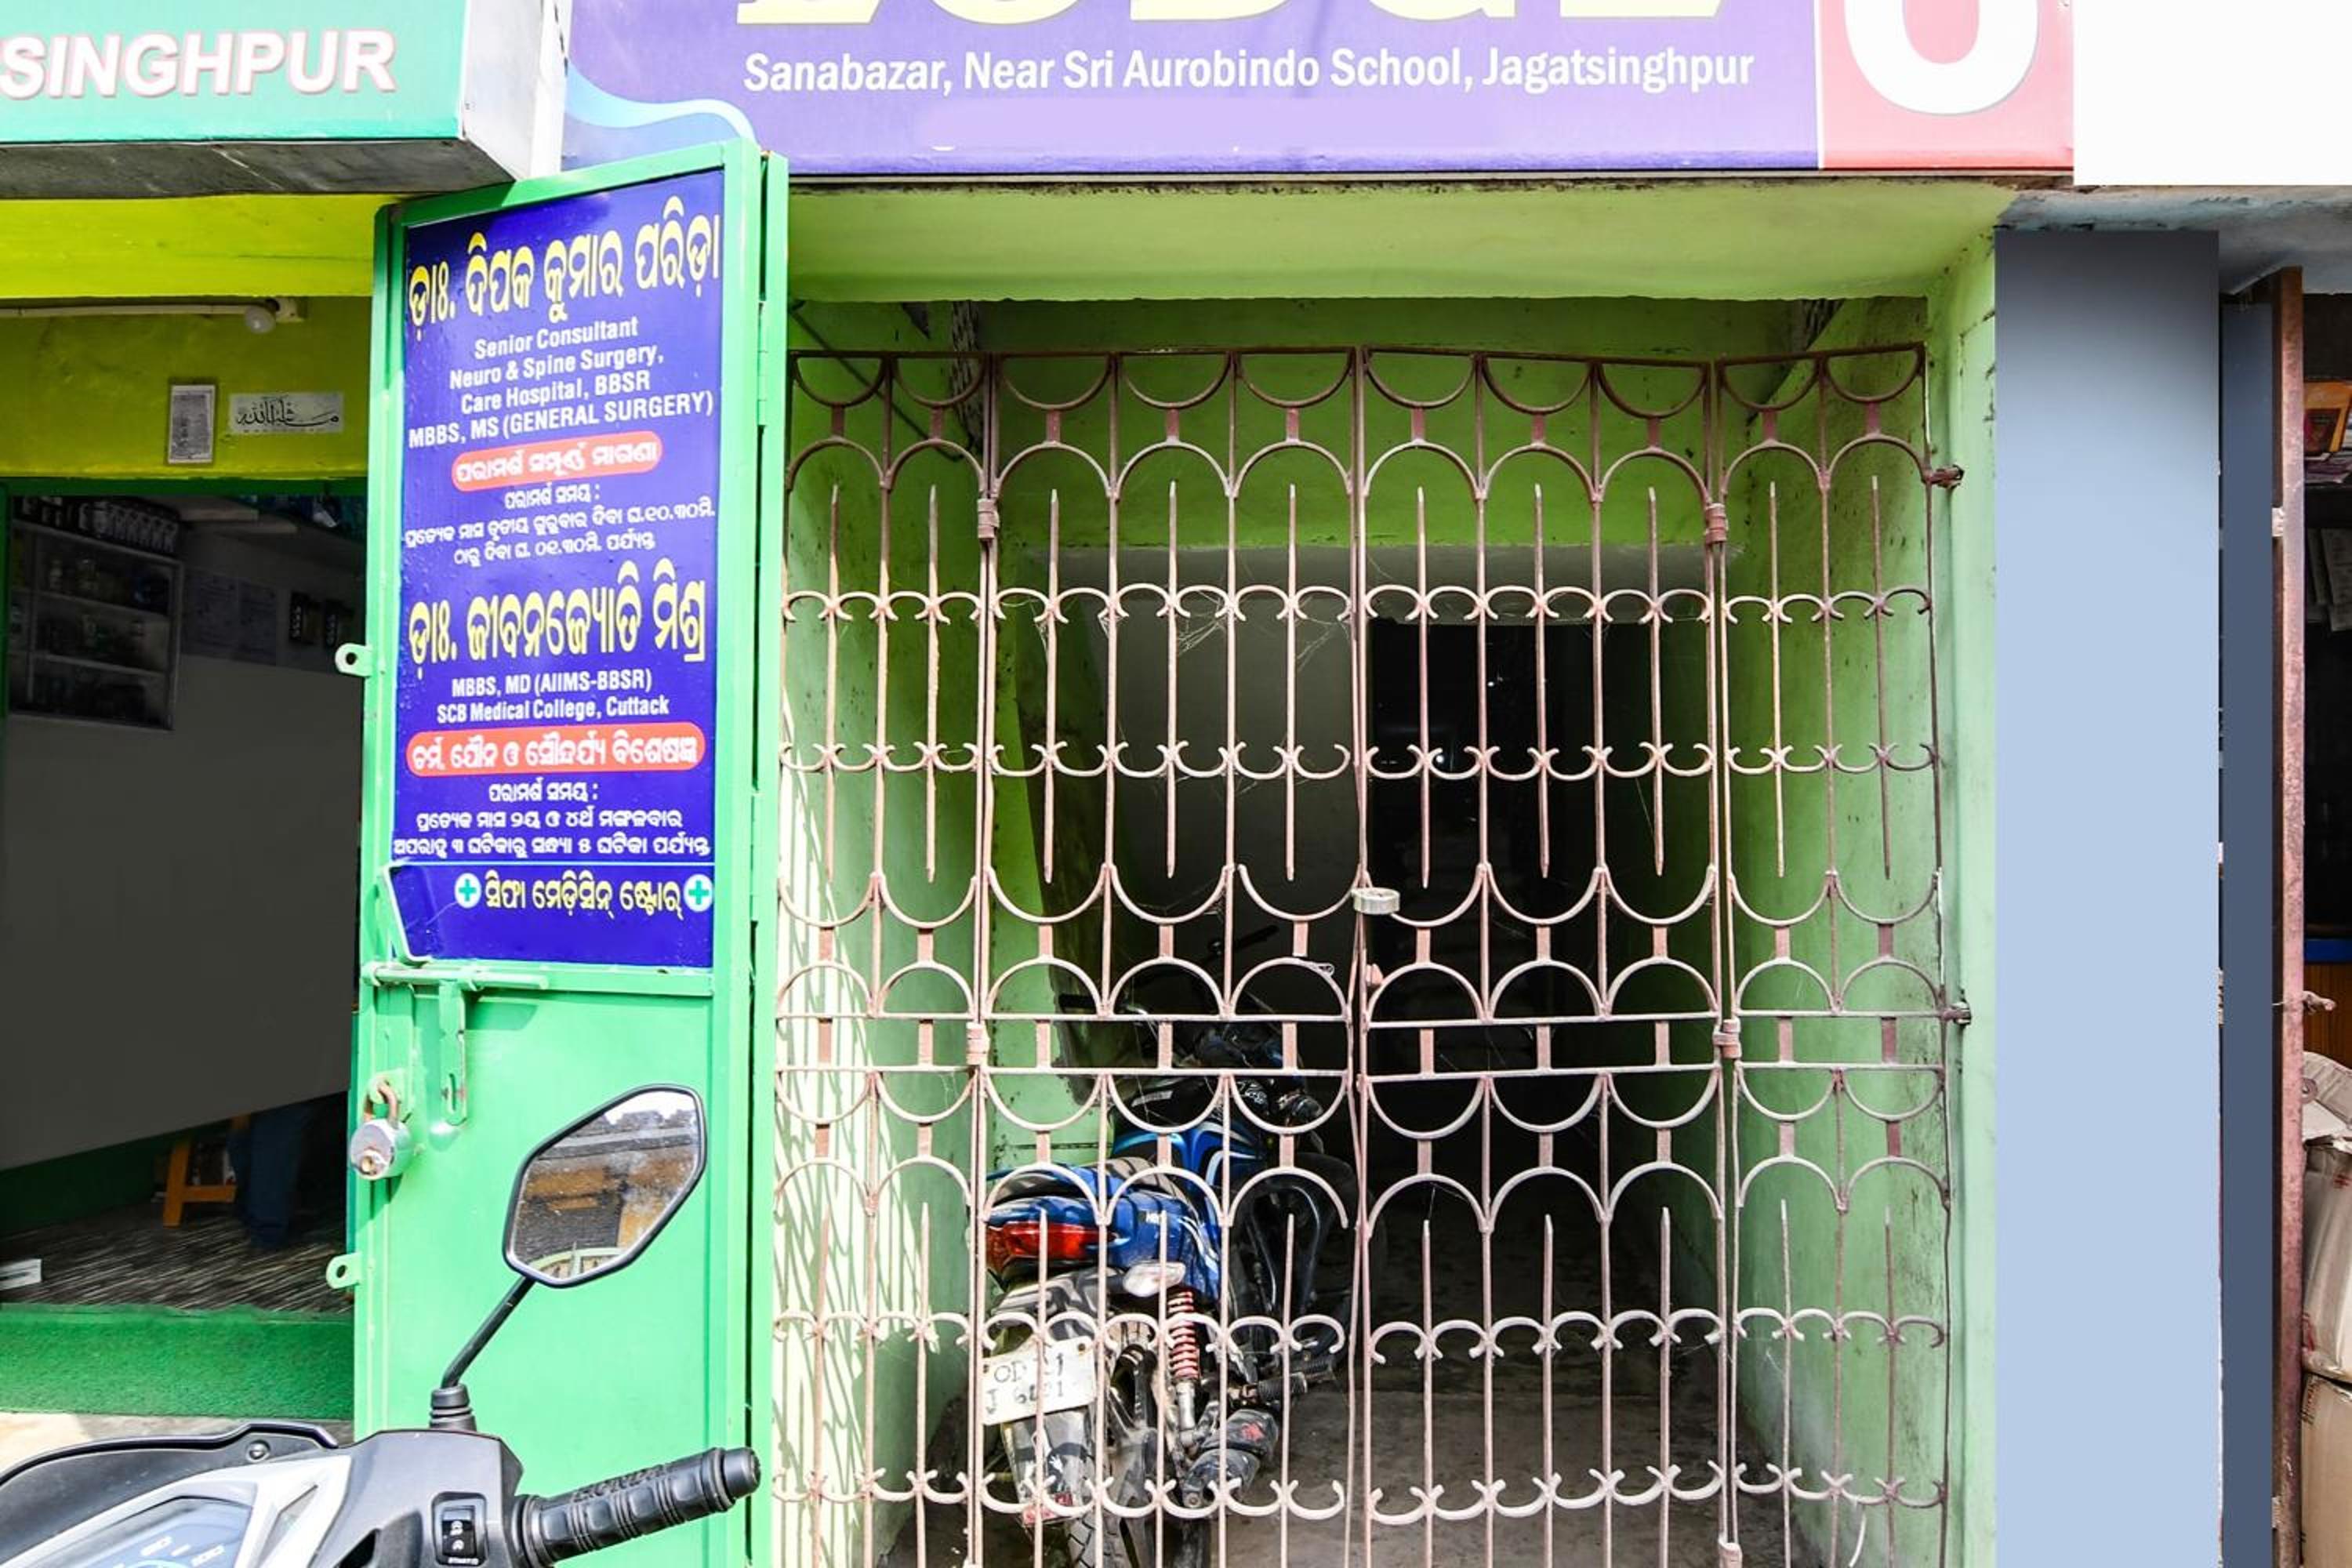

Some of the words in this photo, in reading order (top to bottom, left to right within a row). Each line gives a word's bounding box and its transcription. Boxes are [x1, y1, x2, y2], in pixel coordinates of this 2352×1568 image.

[0, 30, 396, 100] SINGHPUR
[744, 53, 953, 96] Sanabazar,
[964, 52, 1054, 89] Near
[1063, 50, 1114, 89] Sri
[1123, 48, 1319, 88] Aurobindo
[1330, 48, 1473, 92] School,
[1483, 47, 1755, 94] Jagatsinghpur
[544, 230, 624, 323] କୁମାର
[635, 195, 720, 298] ପରିଡ଼ା
[474, 334, 534, 360] Senior
[536, 316, 639, 350] Consultant
[449, 367, 502, 390] Neuro
[506, 360, 519, 381] &
[523, 354, 576, 381] Spine
[580, 345, 664, 370] Surgery,
[461, 393, 503, 415] Care
[506, 377, 590, 407] Hospital,
[595, 369, 651, 396] BBSR
[408, 423, 466, 448] MBBS,
[470, 416, 499, 440] MS
[503, 403, 601, 440] (GENERAL
[604, 389, 714, 423] SURGERY)
[591, 441, 659, 466] ମାଗଣା
[459, 521, 485, 539] ମାସ
[652, 557, 706, 662] ମିଶ୍ର
[452, 677, 501, 698] MBBS,
[505, 674, 532, 695] MD
[535, 667, 653, 695] (AIIMS-BBSR)
[437, 704, 467, 724] SCB
[470, 700, 530, 721] Medical
[532, 699, 602, 722] College,
[606, 695, 670, 717] Cuttack
[503, 741, 521, 767] ଓ
[476, 811, 507, 828] ମାସ
[545, 810, 561, 828] ଓ
[597, 831, 648, 854] ଘଟିକା
